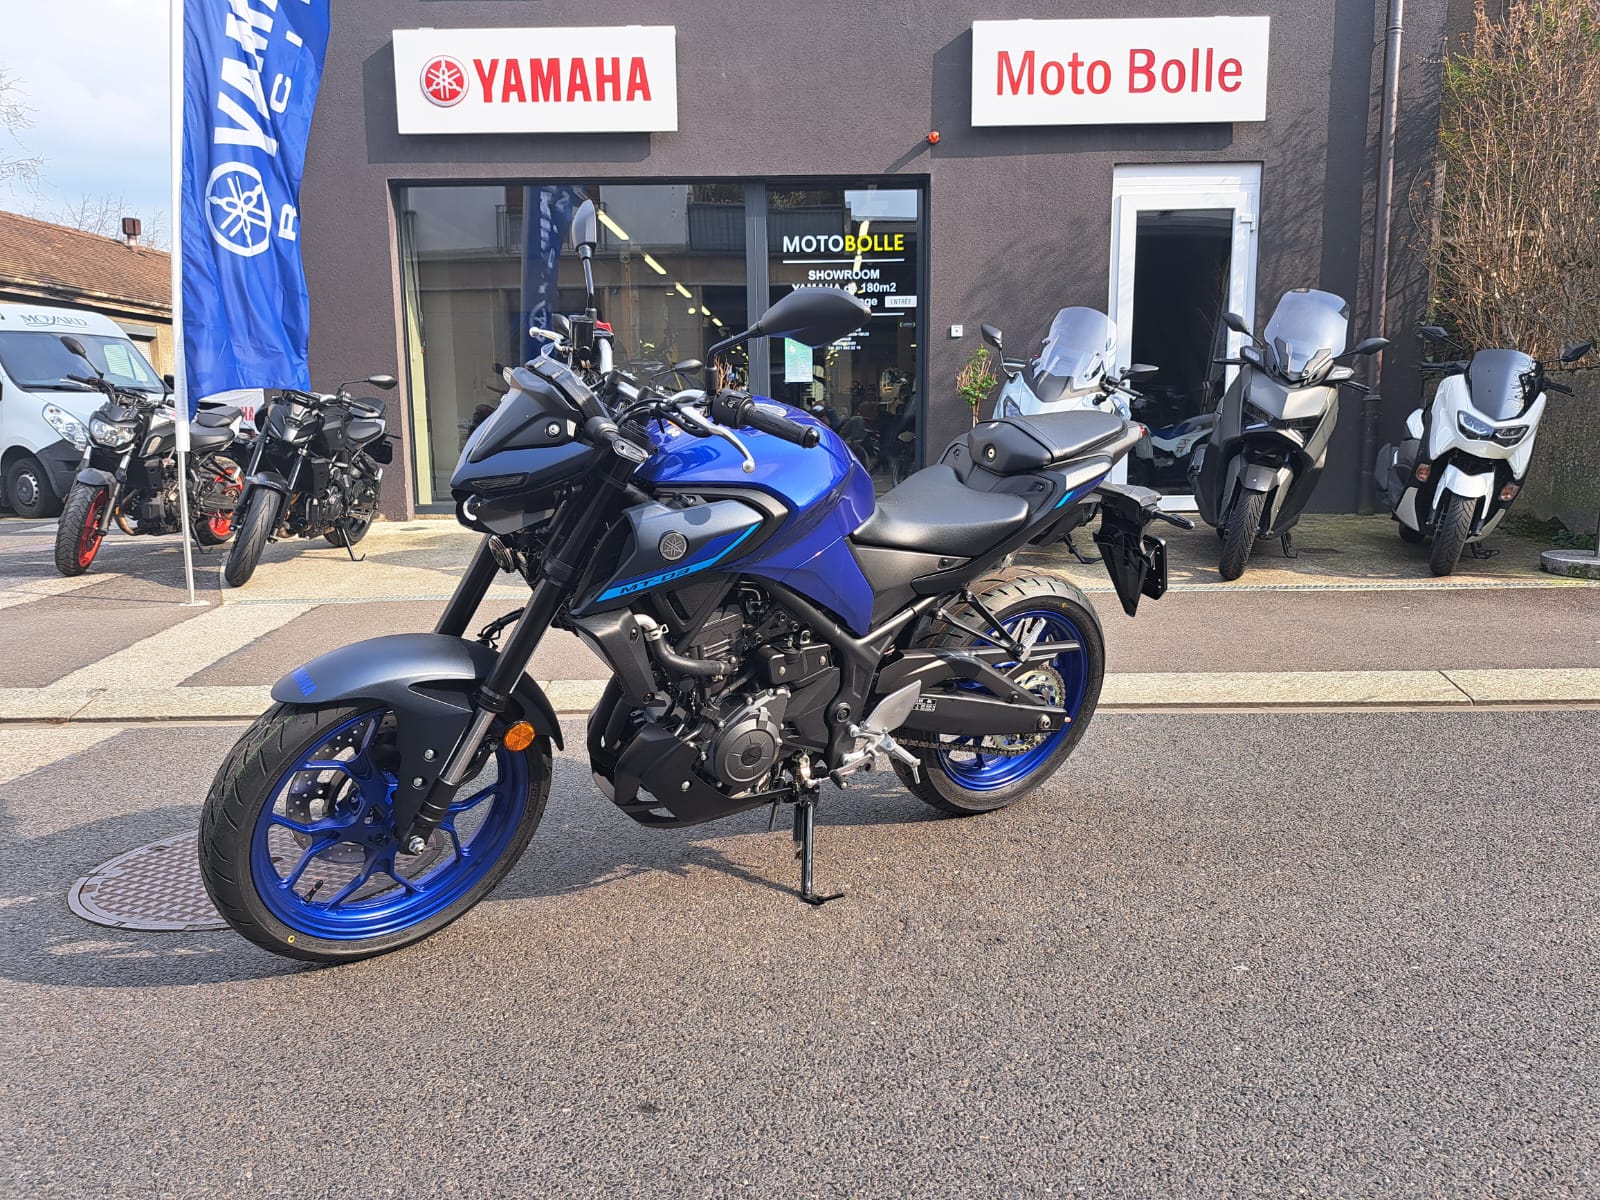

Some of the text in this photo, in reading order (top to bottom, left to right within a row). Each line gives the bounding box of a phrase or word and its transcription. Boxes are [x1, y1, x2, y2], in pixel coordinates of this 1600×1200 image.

[213, 0, 278, 158] YAM
[472, 57, 652, 103] YAMAHA
[997, 47, 1243, 96] Moto Bolle
[783, 234, 905, 253] MOTOBOLLE
[808, 269, 880, 281] SHOWROOM
[861, 282, 897, 293] 180m2
[19, 313, 88, 328] MOYARD
[619, 567, 691, 594] MT-03
